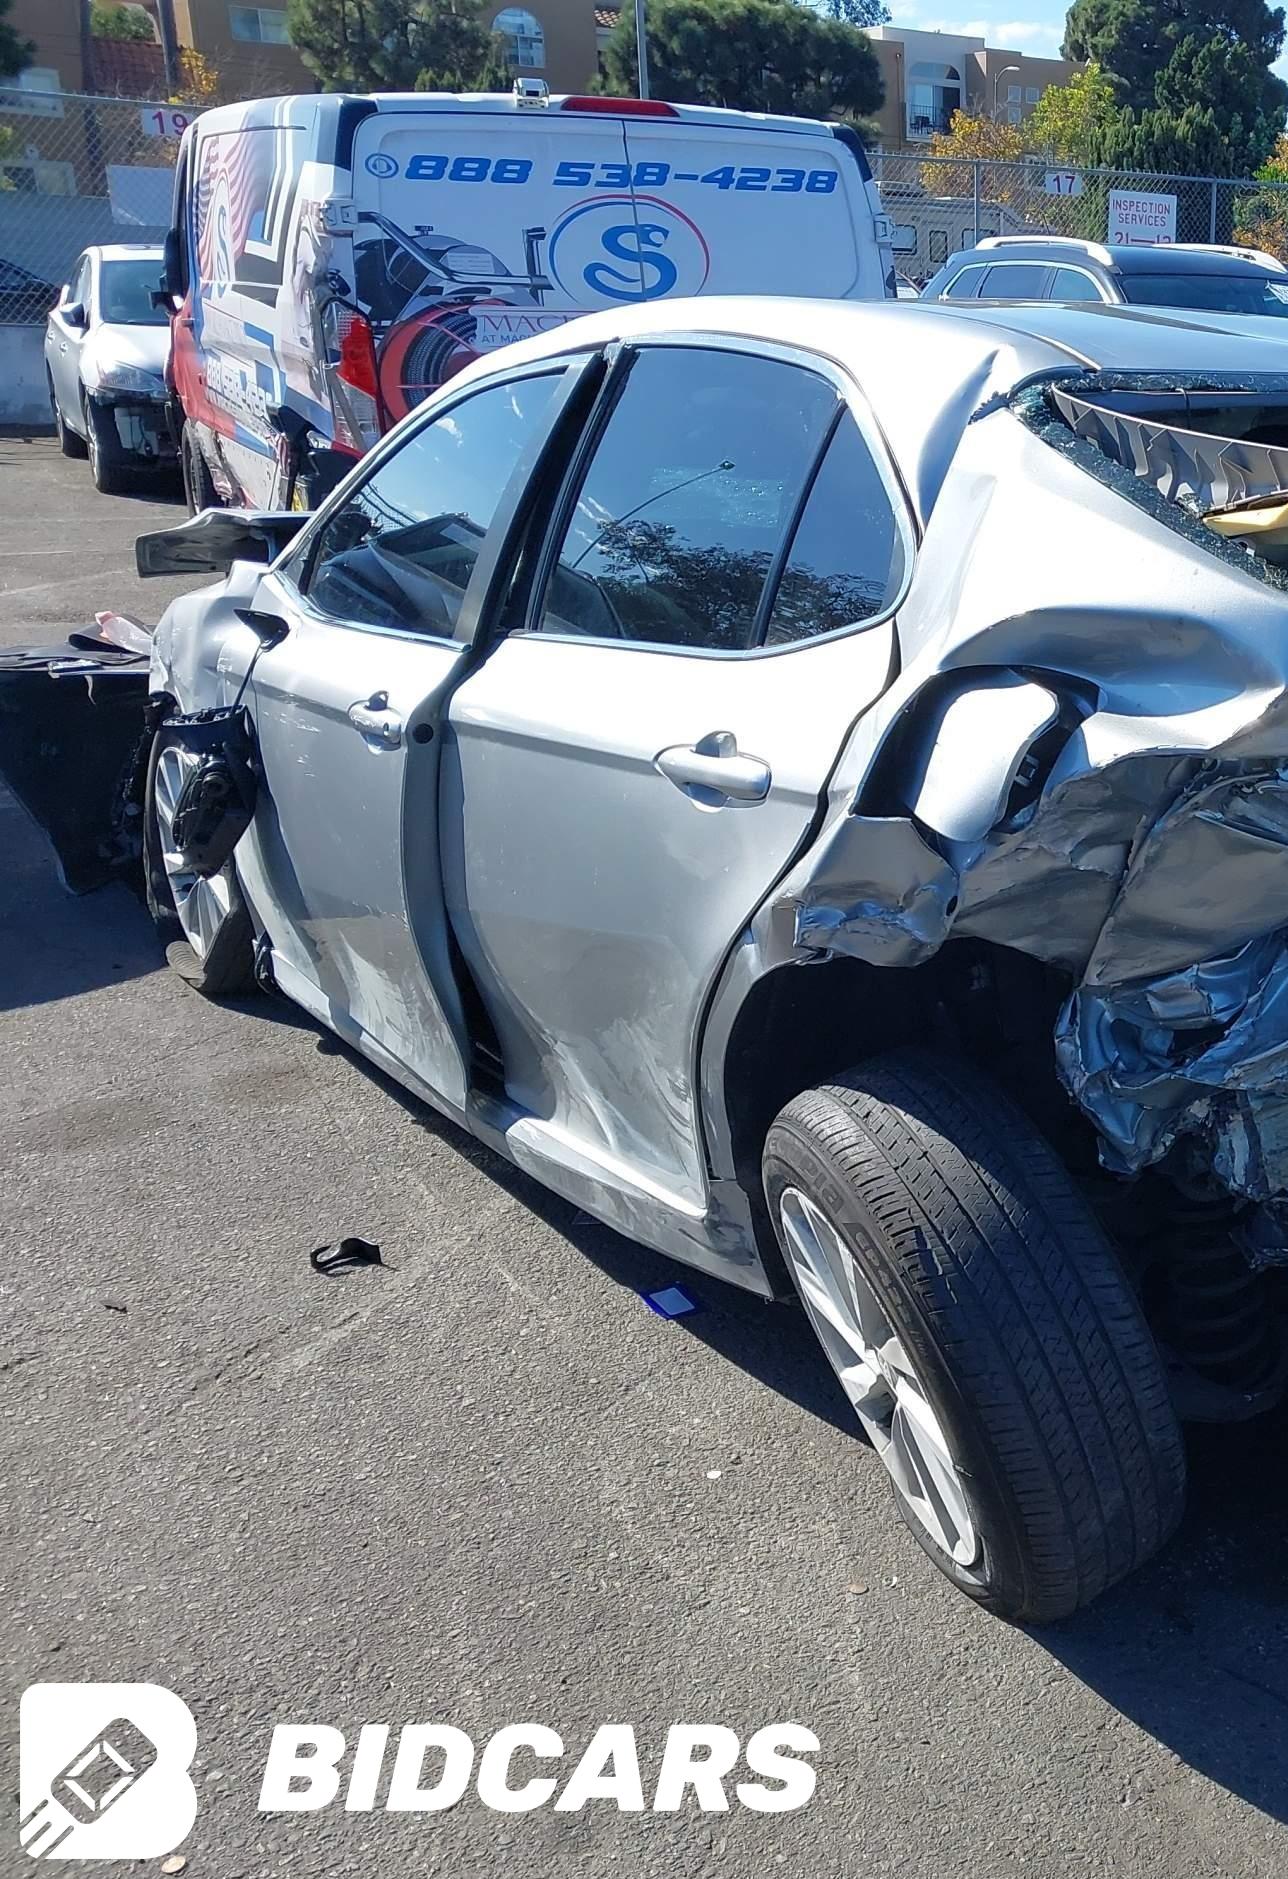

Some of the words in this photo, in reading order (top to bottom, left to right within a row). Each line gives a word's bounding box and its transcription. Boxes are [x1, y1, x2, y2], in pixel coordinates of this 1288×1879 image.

[152, 111, 188, 135] 19
[404, 154, 533, 185] 888
[552, 161, 838, 194] 538-4238
[1053, 175, 1075, 193] 17
[1112, 199, 1171, 215] INSPECTION
[1118, 212, 1166, 227] SERVICES
